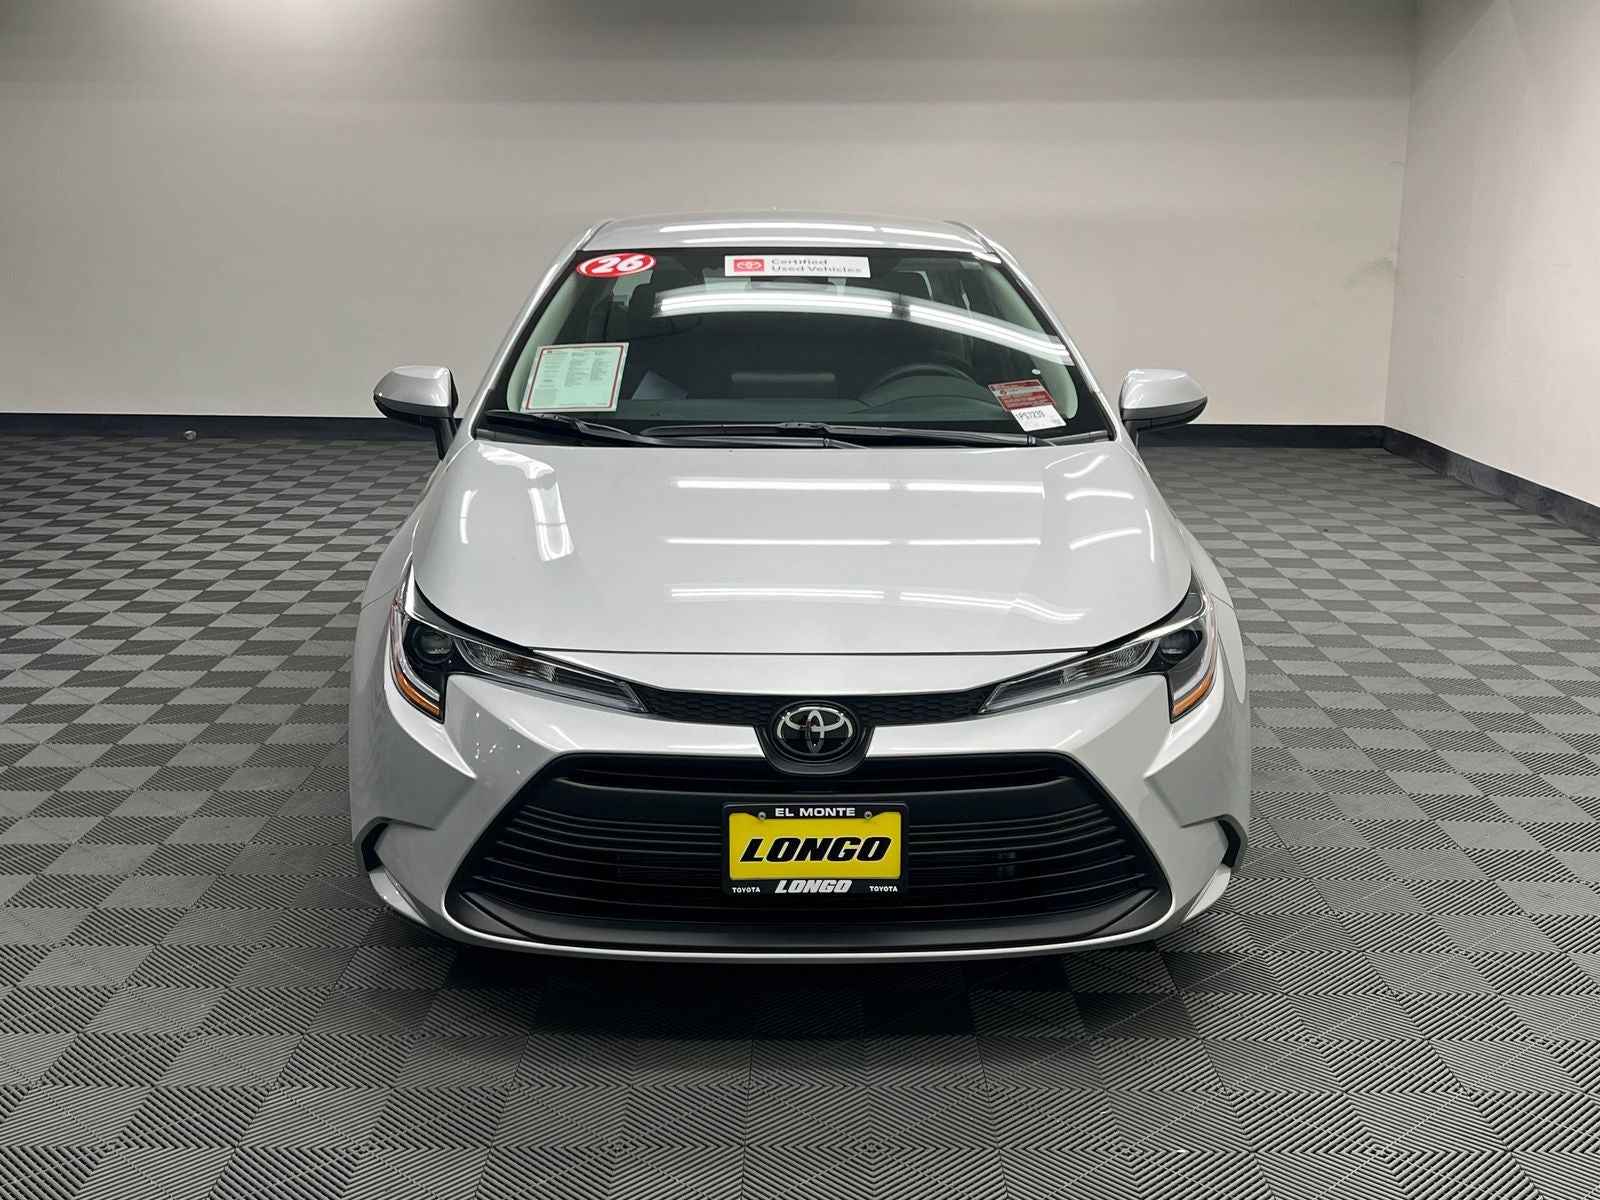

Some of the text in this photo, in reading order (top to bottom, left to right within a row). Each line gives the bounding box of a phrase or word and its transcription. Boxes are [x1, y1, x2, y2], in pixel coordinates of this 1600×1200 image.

[591, 255, 646, 274] 26
[775, 807, 856, 817] EL MONTE
[740, 836, 892, 863] LONGO
[732, 886, 761, 894] TOYOTA
[774, 879, 853, 894] LONGO
[869, 885, 898, 893] TOYOTA
